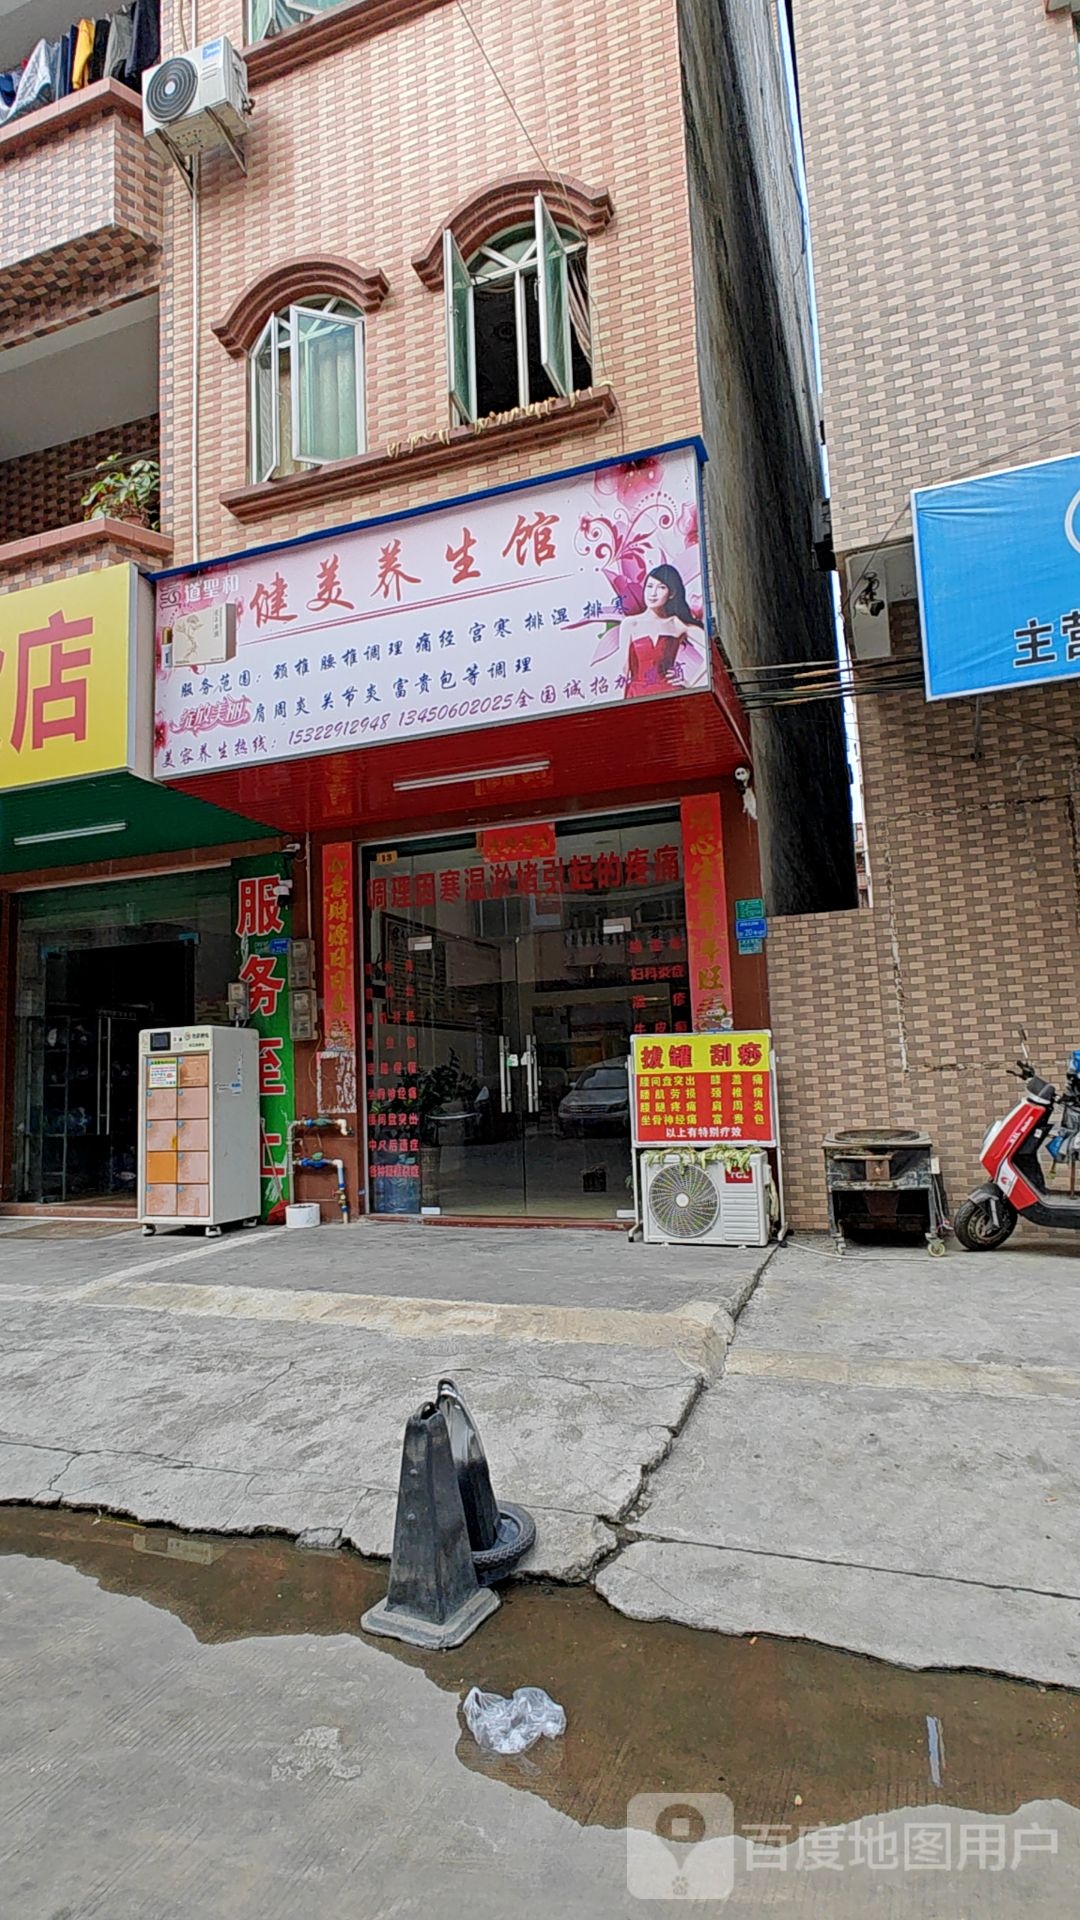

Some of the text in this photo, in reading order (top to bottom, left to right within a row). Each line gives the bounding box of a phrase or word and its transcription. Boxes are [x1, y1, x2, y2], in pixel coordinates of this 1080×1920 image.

[249, 511, 562, 629] 健美养生馆
[0, 609, 95, 754] 店
[641, 1042, 763, 1070] 拔罐 刮痧
[666, 1126, 742, 1138] 以上有特别疗效
